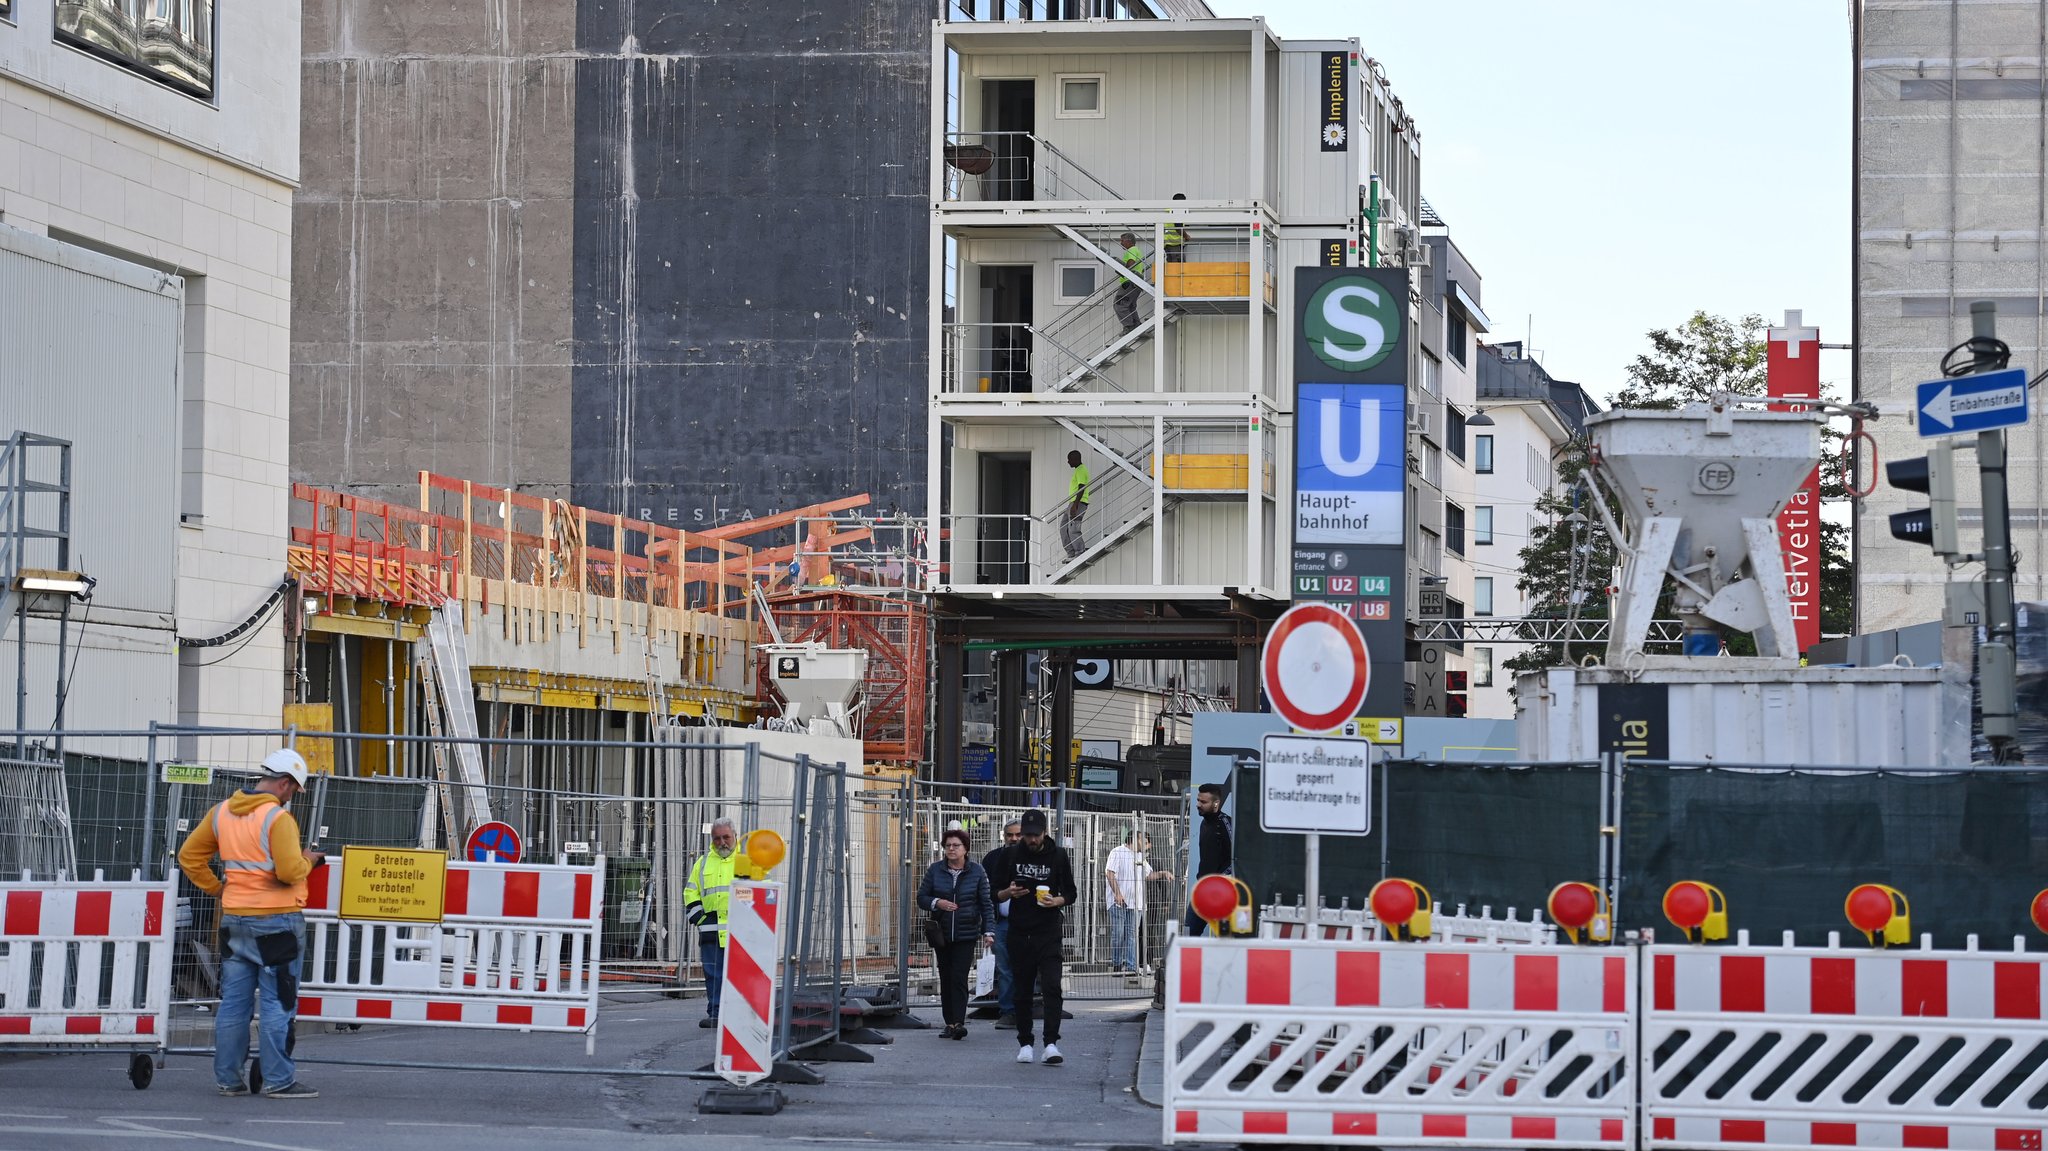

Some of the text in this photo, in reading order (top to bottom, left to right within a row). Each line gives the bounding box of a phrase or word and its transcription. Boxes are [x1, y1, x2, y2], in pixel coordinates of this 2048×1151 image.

[1328, 56, 1344, 121] Implenia
[1322, 285, 1385, 362] S
[1950, 391, 2021, 412] Einbahnstraße
[1320, 399, 1380, 477] U
[1300, 493, 1357, 512] Haupt-
[640, 508, 888, 521] RESTAUANT
[1300, 513, 1369, 530] bahnhof
[1295, 551, 1343, 567] Eingang F
[1783, 491, 1809, 620] Helvetia
[1295, 563, 1325, 571] Entrance
[1300, 578, 1385, 592] U1 U2 U4
[1422, 594, 1439, 605] HR
[1364, 603, 1385, 617] U8
[1266, 750, 1363, 767] Zufahrt Schillerstraße
[1268, 788, 1361, 806] Einsatzfahrzeuge frei
[374, 854, 415, 866] Betreten
[362, 867, 425, 880] der Baustelle
[370, 882, 415, 894] verboten!
[357, 895, 426, 906] Eltern haften für ihre
[379, 905, 402, 914] Kinder!
